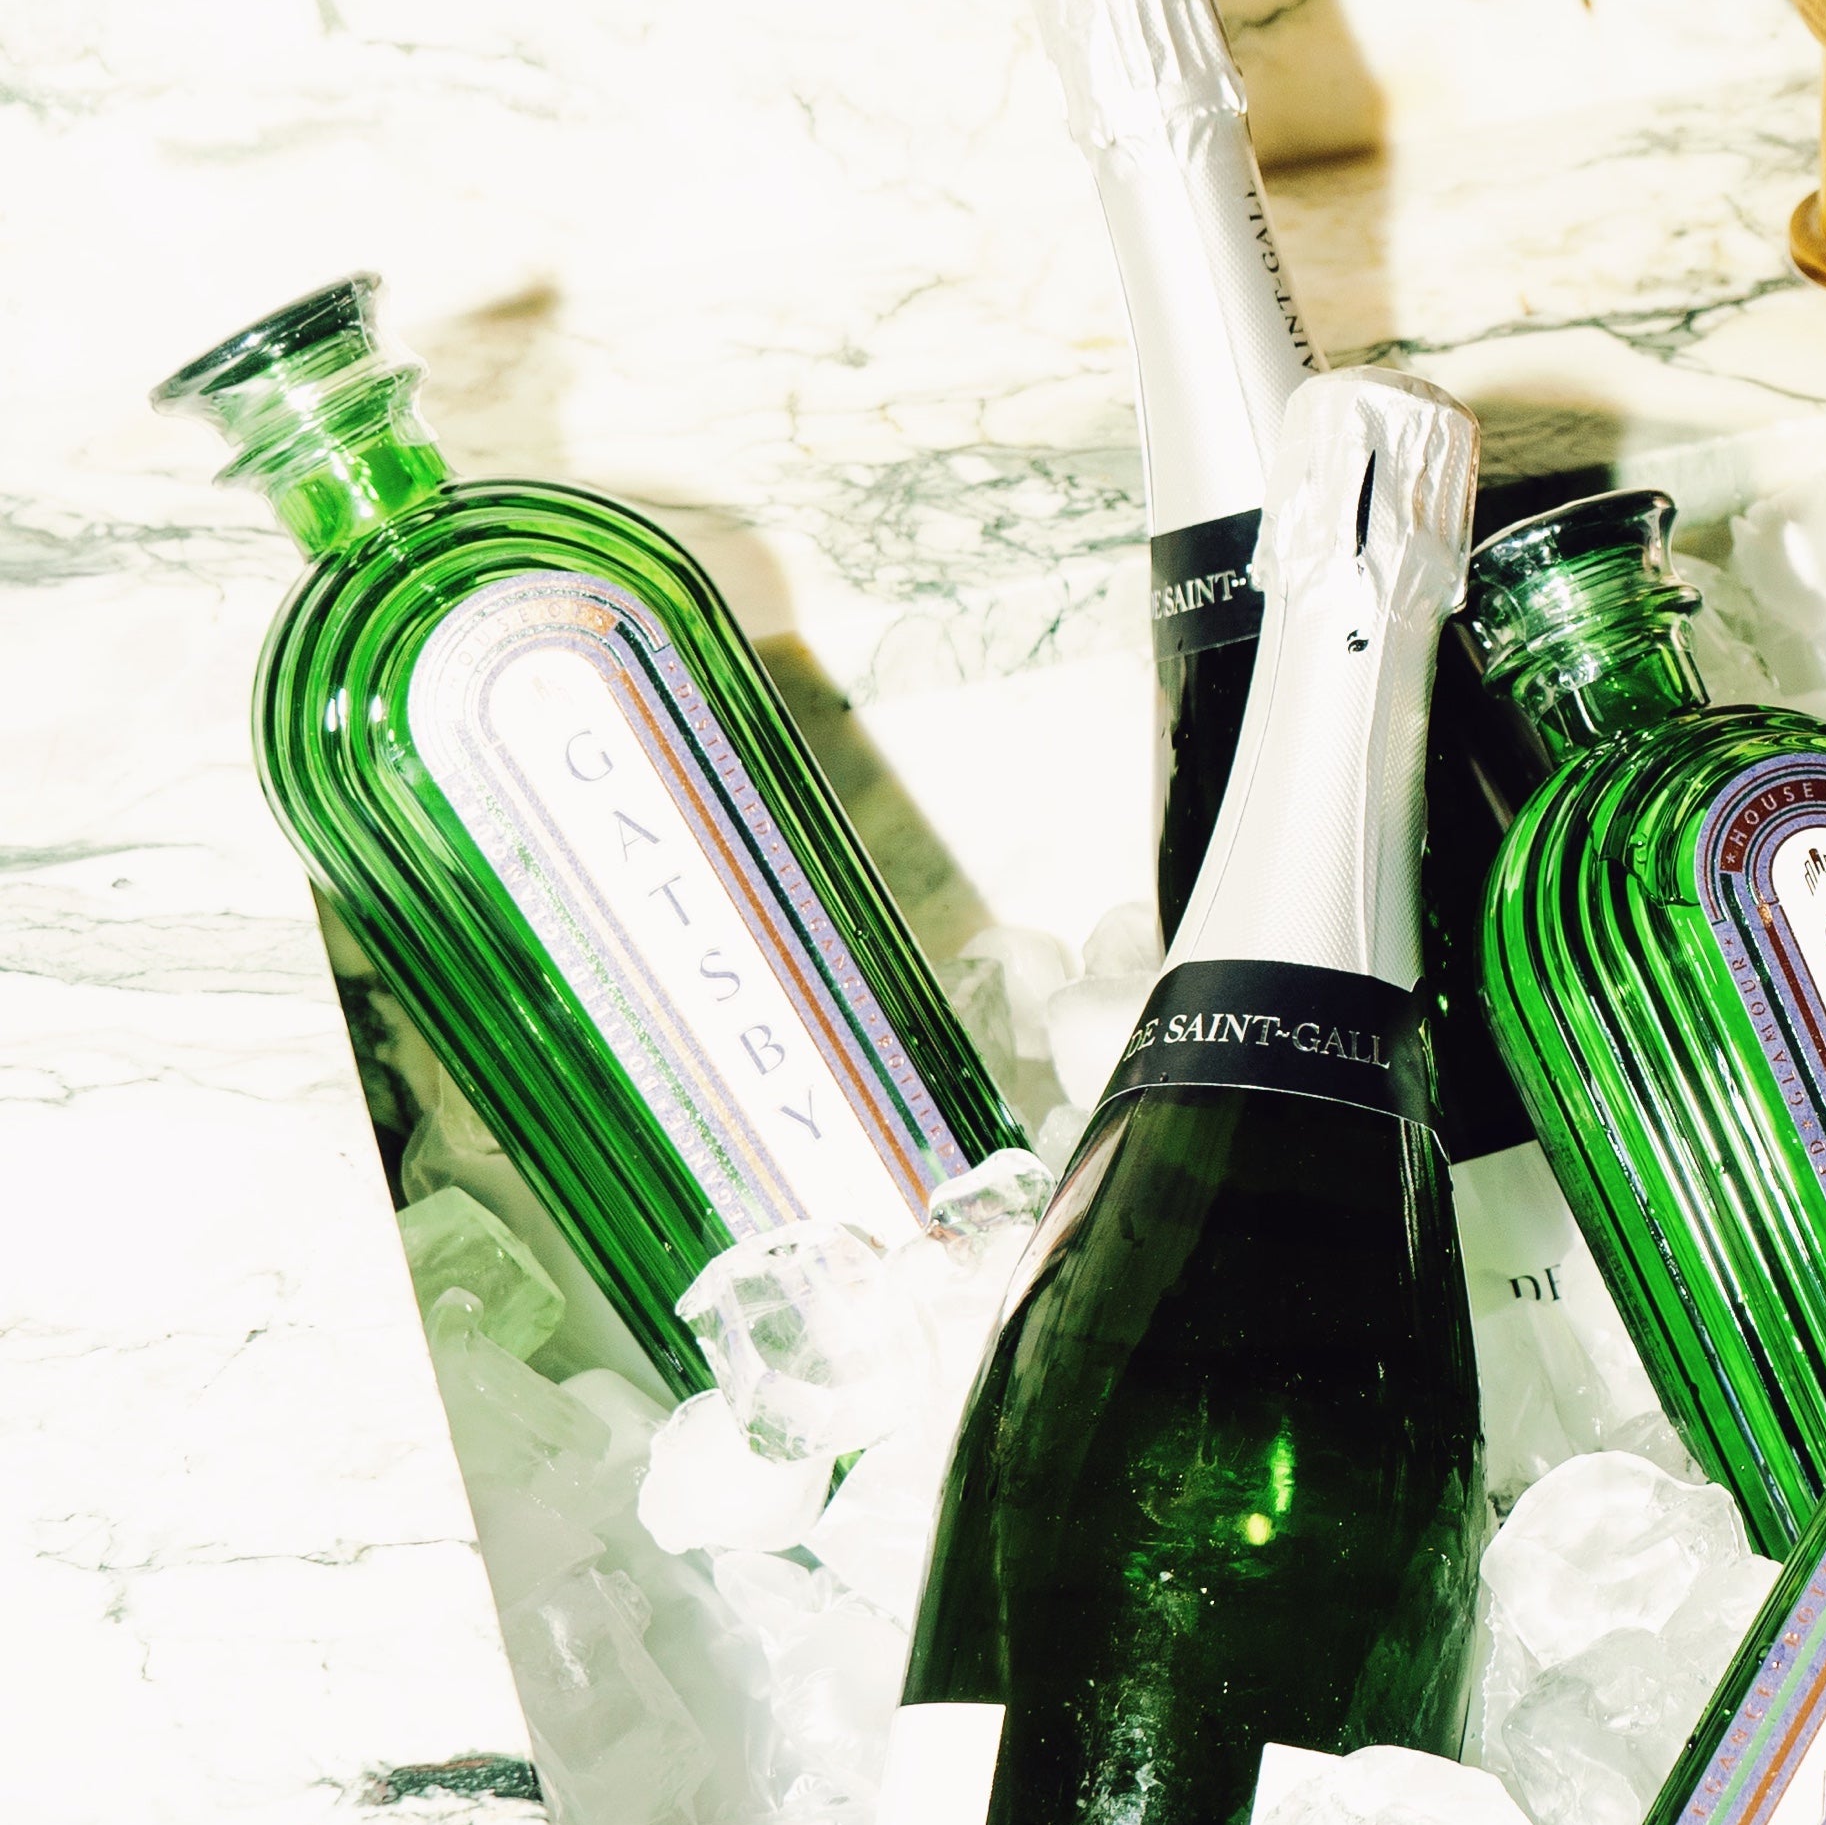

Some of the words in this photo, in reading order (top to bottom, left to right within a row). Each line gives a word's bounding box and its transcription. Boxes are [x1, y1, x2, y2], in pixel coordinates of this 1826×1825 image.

[1245, 180, 1320, 373] AINT-GALL
[1730, 782, 1814, 846] HOUSE
[564, 729, 822, 1140] GATSBY
[674, 681, 772, 837] DISTILLED
[777, 862, 870, 1009] ELEGANCE
[874, 1032, 956, 1159] BOTTLED
[1123, 1018, 1159, 1062] DE
[1729, 955, 1805, 1107] GLAMOUR
[665, 1111, 755, 1240] LEGANCE
